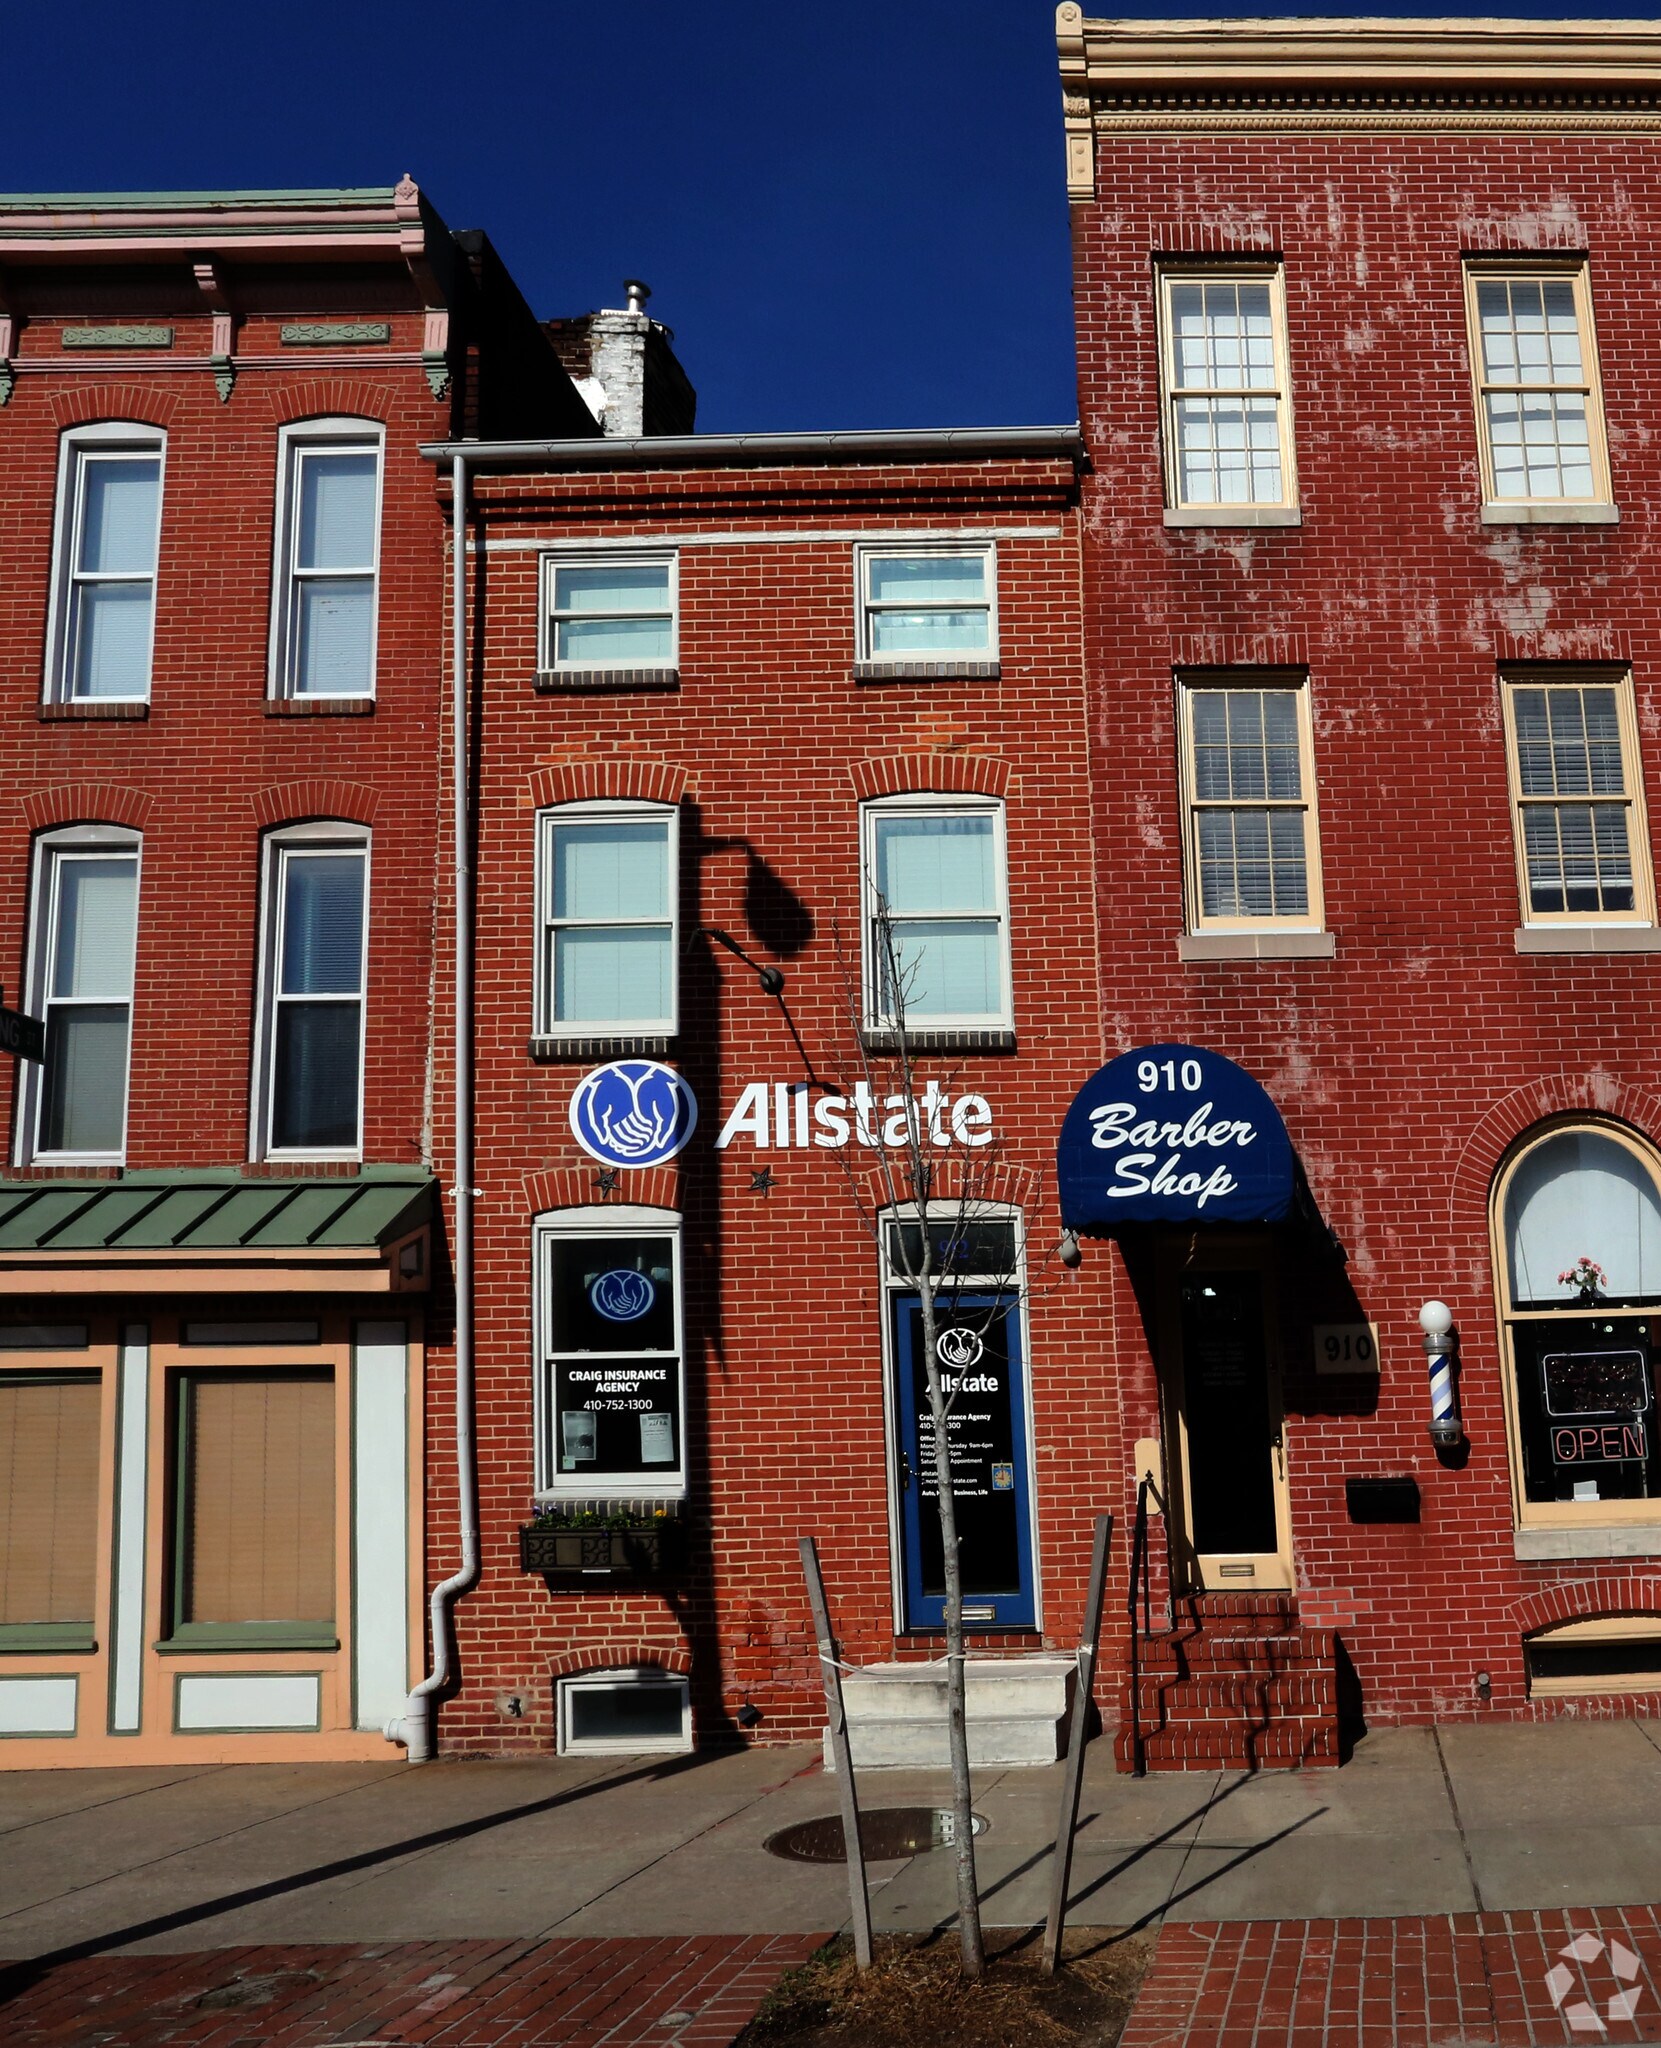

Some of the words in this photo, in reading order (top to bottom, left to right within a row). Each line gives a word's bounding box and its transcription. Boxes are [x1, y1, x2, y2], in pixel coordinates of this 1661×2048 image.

[1137, 1059, 1202, 1093] 910
[713, 1080, 993, 1149] Allstate
[1088, 1101, 1257, 1149] Barber
[1106, 1153, 1238, 1209] Shop
[1325, 1335, 1371, 1362] 910
[568, 1370, 602, 1381] CRAIG
[604, 1369, 667, 1381] INSURANCE
[595, 1382, 640, 1393] AGENCY
[925, 1373, 998, 1393] llstate
[583, 1399, 653, 1410] 410-752-1300
[968, 1413, 991, 1421] Agency
[1556, 1426, 1643, 1460] OPEN
